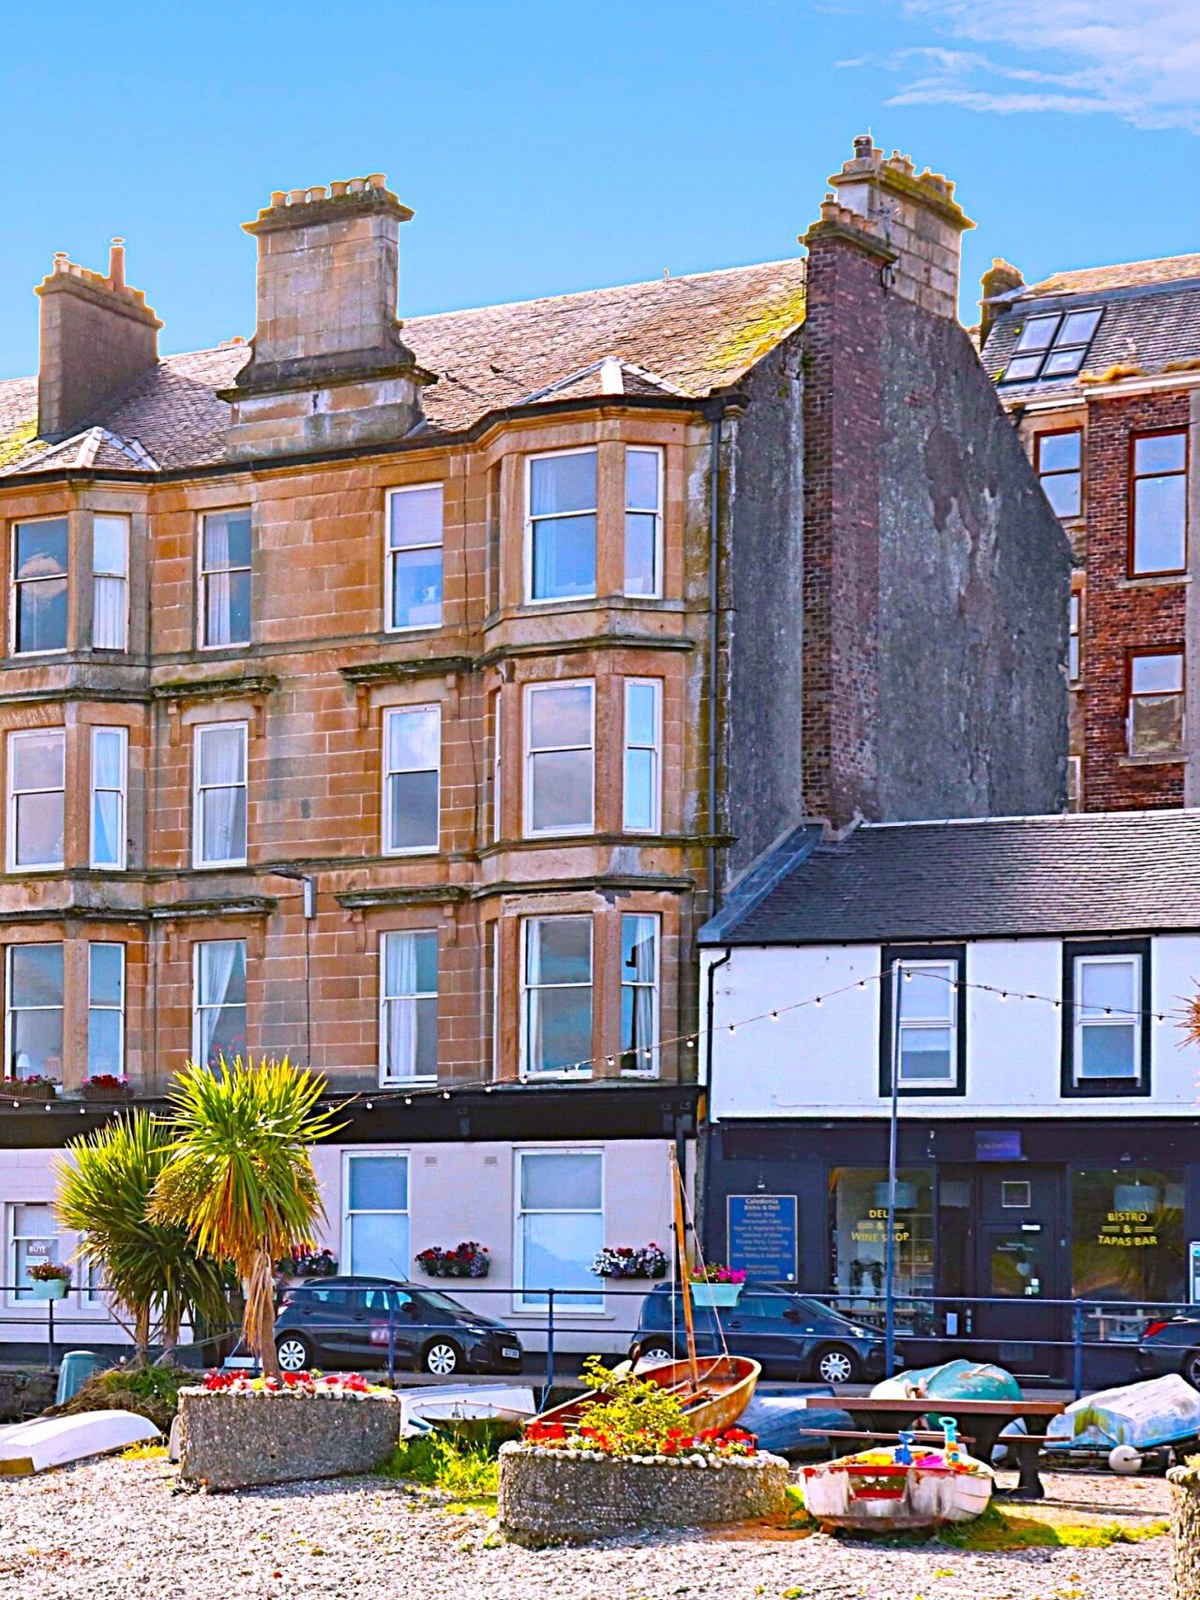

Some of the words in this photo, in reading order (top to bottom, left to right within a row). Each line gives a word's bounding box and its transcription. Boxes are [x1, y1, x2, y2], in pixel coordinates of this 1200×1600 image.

[869, 1209, 890, 1218] DEL
[1107, 1212, 1147, 1222] BISTRO
[877, 1221, 884, 1230] &
[1123, 1224, 1132, 1234] &
[851, 1232, 877, 1242] WINE
[1098, 1235, 1131, 1246] TAPAS
[1134, 1236, 1157, 1246] BAR
